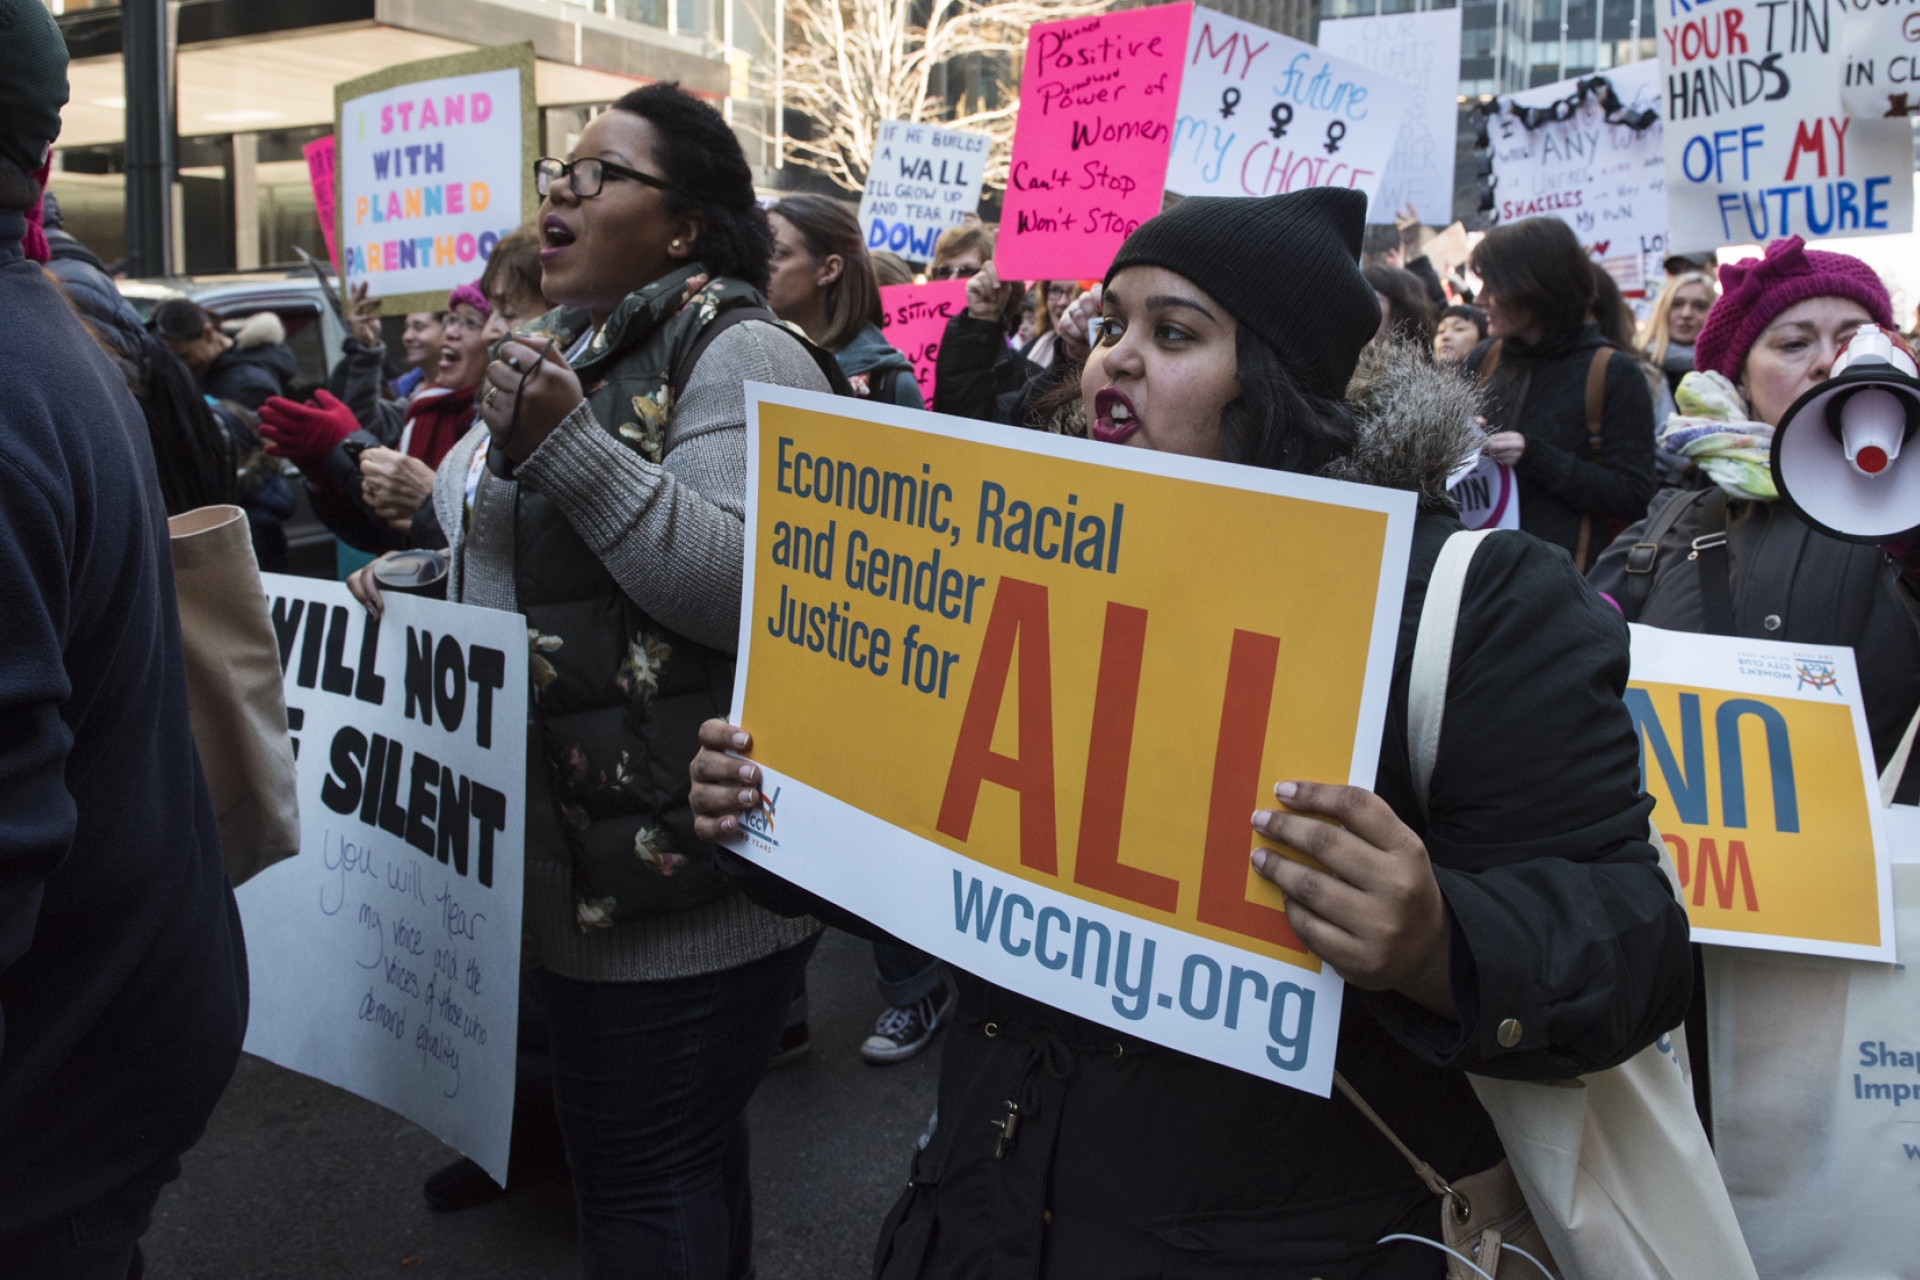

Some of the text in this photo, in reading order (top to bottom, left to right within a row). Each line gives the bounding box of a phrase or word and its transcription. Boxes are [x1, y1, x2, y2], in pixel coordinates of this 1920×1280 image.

[1038, 31, 1164, 78] Positive
[1663, 7, 1749, 67] YOUR
[1037, 72, 1168, 116] Power of
[1192, 23, 1270, 80] MY
[1273, 52, 1369, 121] future
[1669, 53, 1791, 121] HANDS
[380, 92, 492, 134] STAND
[883, 126, 897, 141] IF
[905, 127, 924, 144] HE
[1072, 116, 1169, 151] Women
[373, 142, 445, 181] WITH
[881, 147, 968, 187] A WALL
[1541, 128, 1600, 166] ANY
[1683, 124, 1764, 183] OFF
[1784, 117, 1850, 182] MY
[356, 181, 491, 226] PLANNED
[895, 183, 937, 200] GROW
[944, 190, 963, 204] UP
[1013, 160, 1137, 200] Can't Stop
[869, 201, 966, 223] AND TEAR IT
[1017, 206, 1078, 236] Won't
[1718, 176, 1891, 241] FUTURE
[345, 229, 516, 276] PARENTHOO
[777, 436, 1124, 574] Economic, Racial
[771, 519, 986, 625] and Gender
[768, 583, 960, 700] Justice for
[265, 594, 386, 706] WILL
[404, 624, 506, 750] NOT
[1768, 662, 1791, 671] CITY
[935, 575, 1310, 956] ALL
[321, 725, 507, 890] SILENT
[751, 838, 772, 854] YEARS
[320, 828, 378, 916] You
[387, 860, 426, 906] will
[355, 903, 482, 996] my voice and the
[951, 868, 1316, 1072] wccny.org
[425, 972, 437, 1023] of
[438, 987, 463, 1028] those
[463, 1015, 488, 1046] who
[358, 985, 461, 1099] demand equality
[1859, 1041, 1920, 1076] Sha
